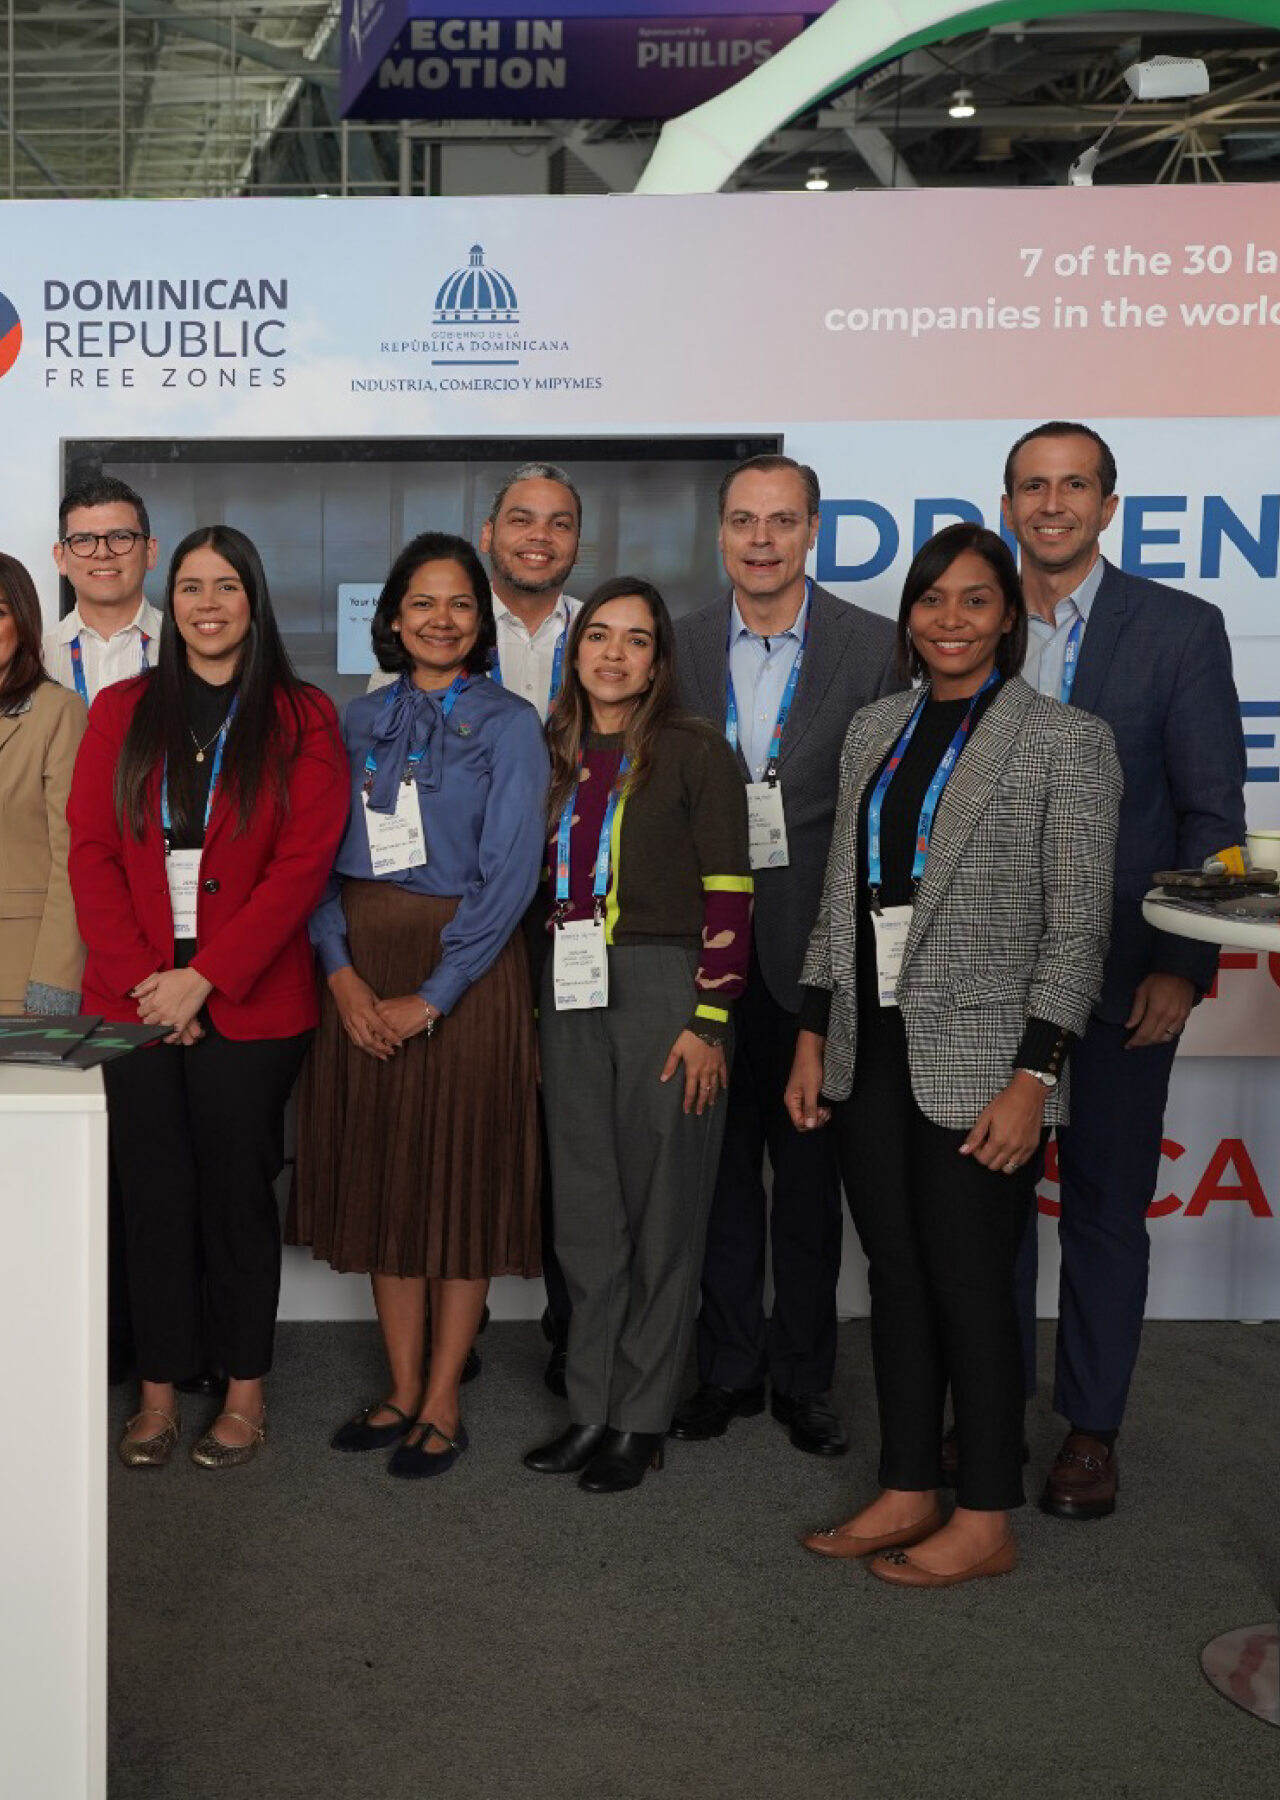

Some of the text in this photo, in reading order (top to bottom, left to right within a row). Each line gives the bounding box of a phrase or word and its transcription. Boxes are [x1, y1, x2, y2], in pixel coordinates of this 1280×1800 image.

[394, 20, 563, 50] ECH IN
[637, 38, 773, 69] PHILIPS
[378, 58, 566, 89] MOTION
[1020, 247, 1043, 277] 7
[1055, 245, 1095, 277] of
[1104, 246, 1172, 276] the
[1182, 245, 1232, 274] 30
[44, 279, 288, 311] DOMINICAN
[823, 297, 1042, 338] companies
[1054, 297, 1089, 328] in
[1102, 299, 1168, 328] the
[45, 320, 287, 359] REPUBLIC
[381, 339, 570, 353] REPÚBLICA DOMINICANA
[45, 368, 287, 388] FREE ZONES
[351, 377, 602, 392] INDUSTRIA, COMERCIO Y MIPYMES
